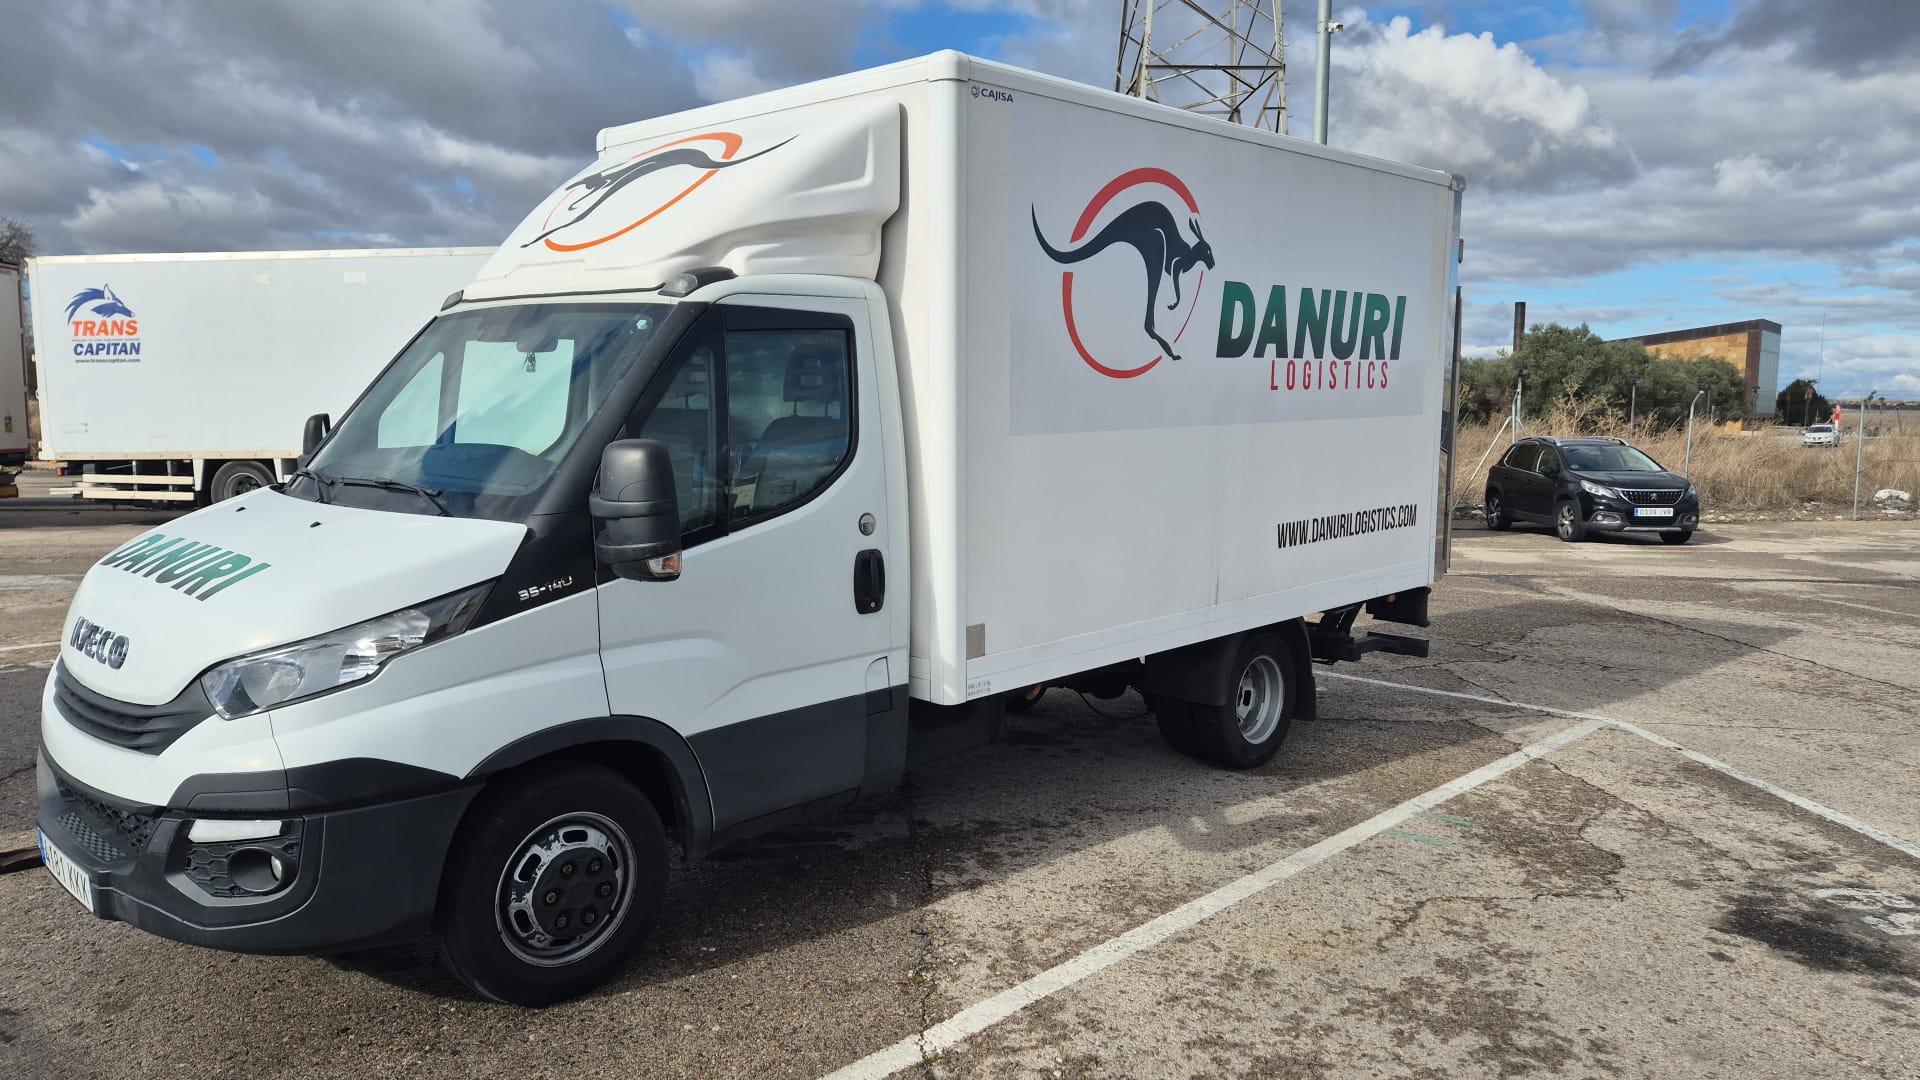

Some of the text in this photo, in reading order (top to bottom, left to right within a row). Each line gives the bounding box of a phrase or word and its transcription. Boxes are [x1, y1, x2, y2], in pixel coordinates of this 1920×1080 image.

[981, 88, 1014, 103] CAJISA
[72, 320, 138, 337] TRANS
[1216, 281, 1407, 360] DANURI
[73, 342, 141, 356] CAPITAN
[1270, 360, 1388, 391] LOGISTICS
[1277, 504, 1417, 549] WWW.DANURILOGISTICS.COM
[99, 533, 272, 601] DANURI
[518, 576, 573, 601] 35-140
[70, 616, 129, 669] IVECO
